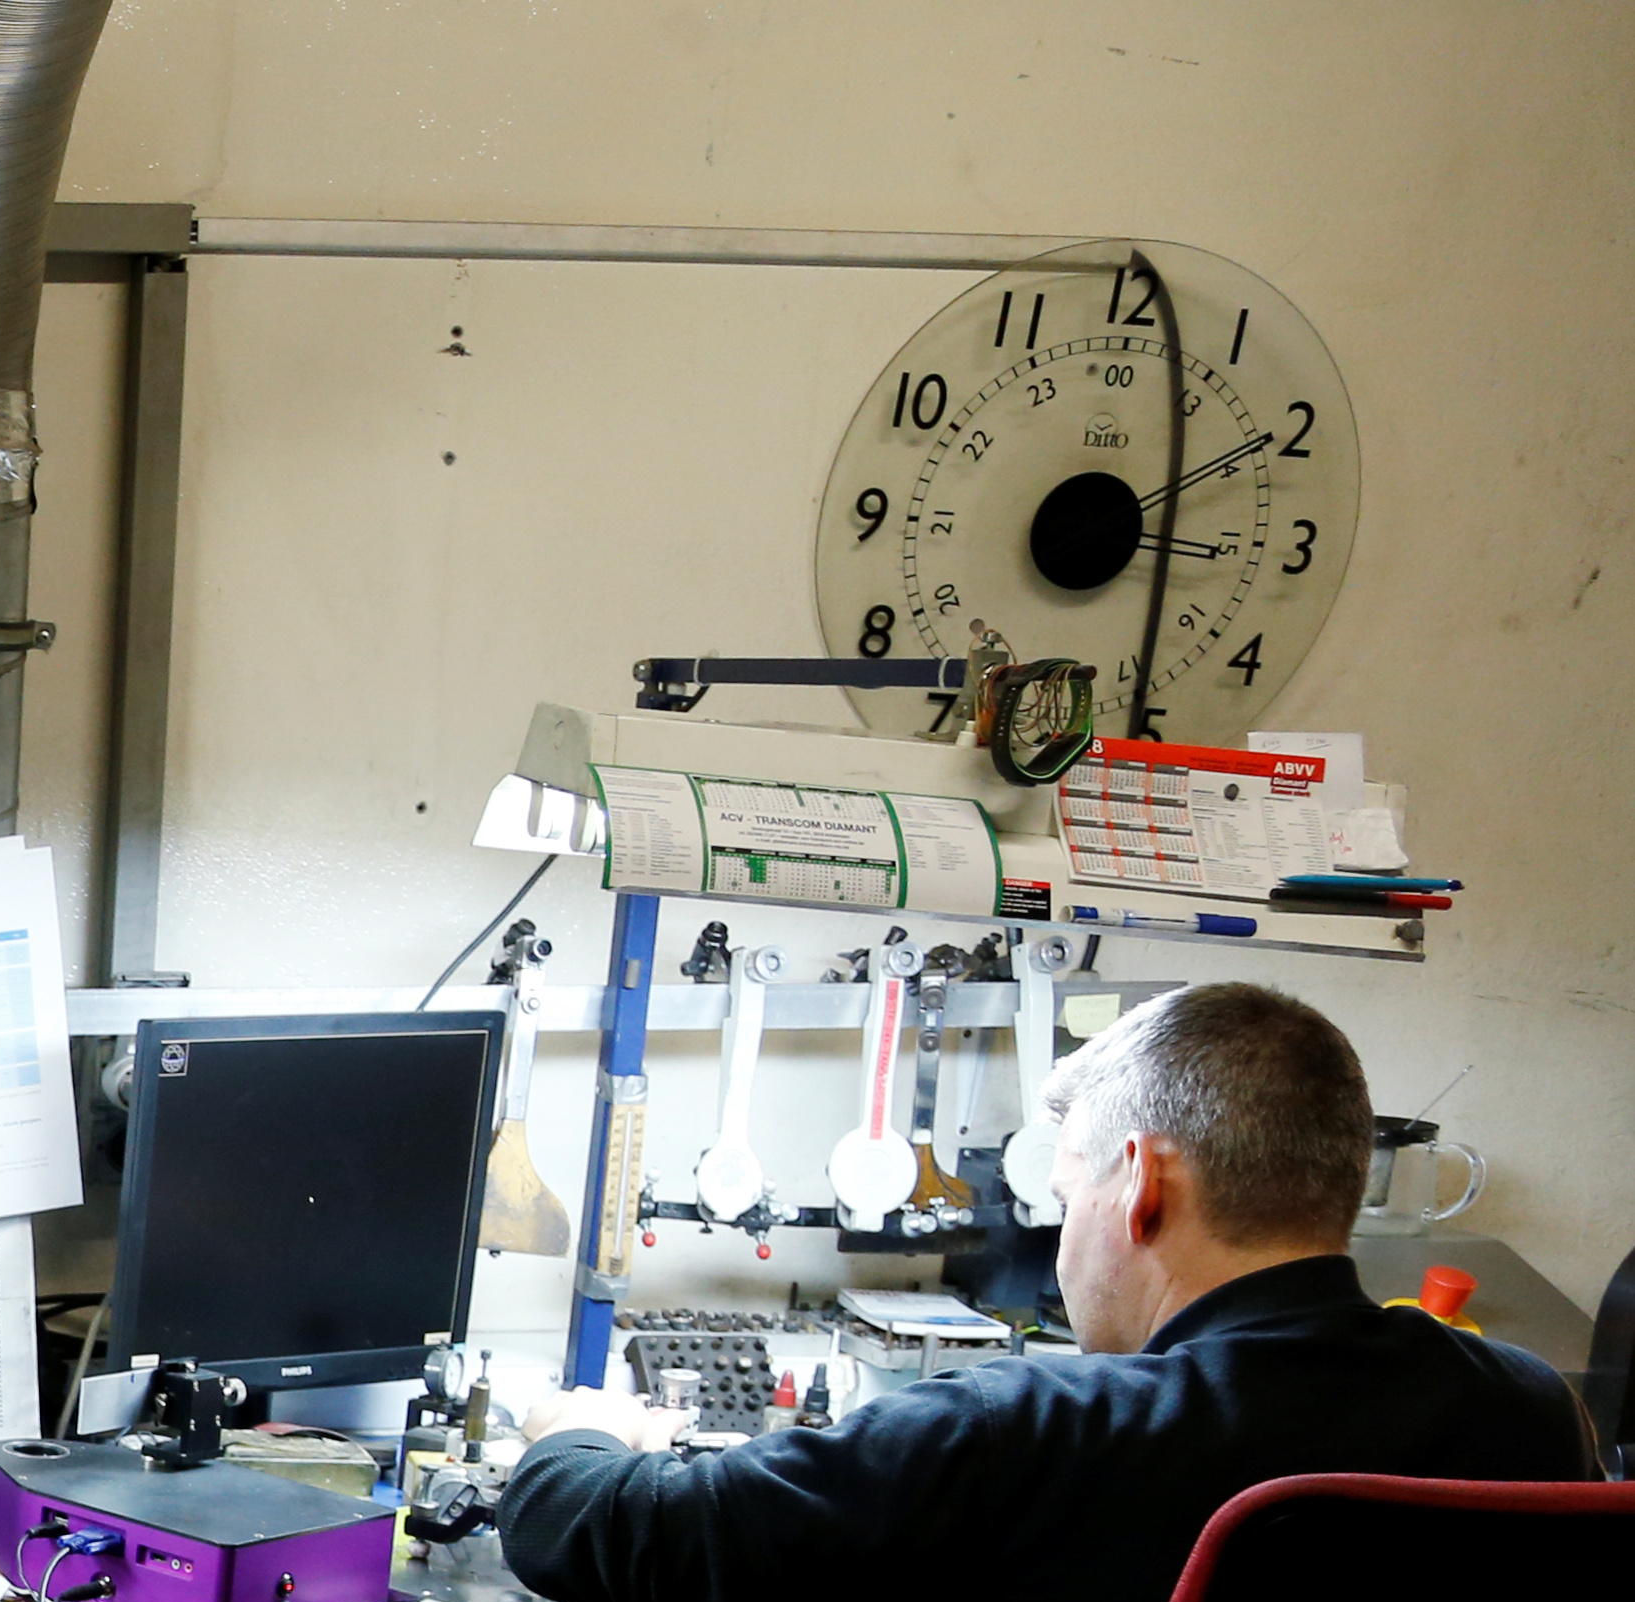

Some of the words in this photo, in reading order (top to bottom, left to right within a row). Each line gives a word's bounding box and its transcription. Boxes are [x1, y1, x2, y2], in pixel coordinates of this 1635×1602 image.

[1106, 266, 1161, 327] 12
[994, 291, 1045, 350] 11
[1228, 307, 1250, 366] 1
[1026, 377, 1058, 409] 23
[1104, 363, 1134, 389] 00
[891, 371, 948, 430] 10
[961, 428, 994, 462] 22
[1278, 400, 1316, 459] 2
[854, 486, 889, 544] 9
[929, 509, 955, 536] 21
[1280, 518, 1317, 576] 3
[933, 582, 961, 616] 20
[1177, 602, 1207, 631] 16
[857, 603, 896, 659] 8
[1227, 632, 1264, 687] 4
[926, 691, 959, 733] 7
[1137, 706, 1167, 743] 5
[1273, 761, 1316, 777] ABVV
[719, 812, 744, 824] ACV
[755, 815, 822, 831] TRANSCOM
[824, 820, 878, 835] DIAMANT
[280, 1365, 313, 1377] PHILIPS
